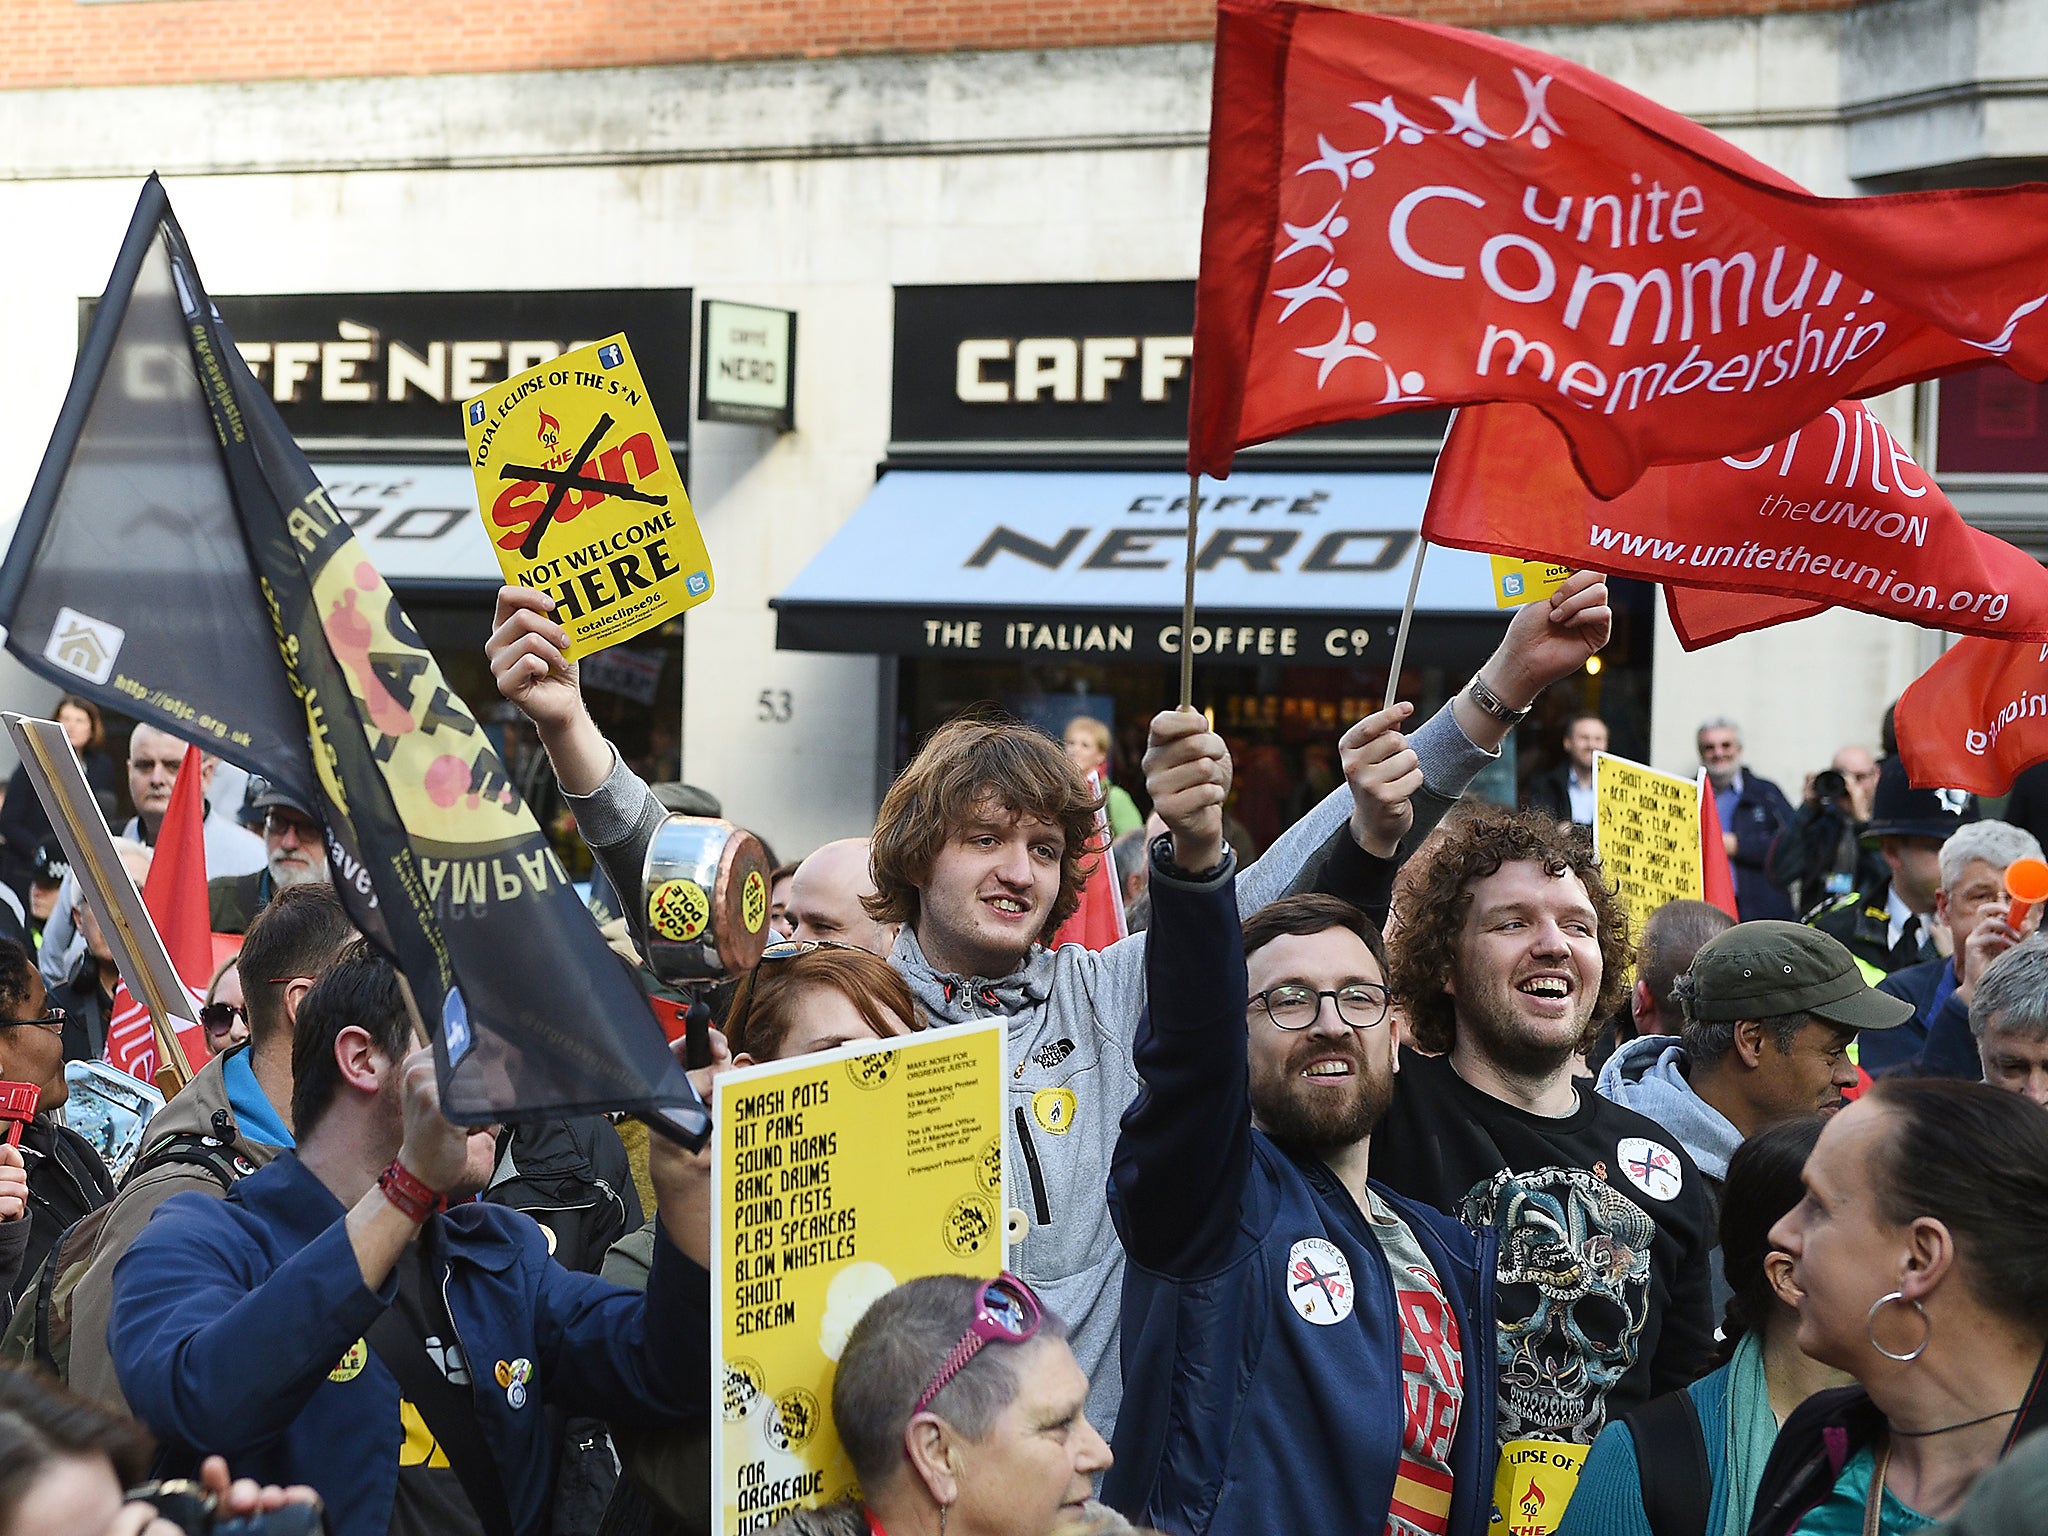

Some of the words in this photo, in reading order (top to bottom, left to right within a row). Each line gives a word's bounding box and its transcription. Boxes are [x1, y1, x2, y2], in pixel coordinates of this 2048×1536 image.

[1522, 172, 1705, 248] unite
[719, 358, 776, 384] NERO
[956, 337, 1193, 401] CAFF
[1476, 312, 1888, 414] membership
[475, 419, 501, 468] TOTAL
[497, 375, 546, 419] ECLIPSE
[549, 371, 570, 387] OF
[574, 371, 604, 391] THE
[542, 430, 558, 446] 96
[540, 448, 574, 471] THE
[1128, 490, 1331, 515] CAFFÈ
[517, 558, 561, 588] NOT
[564, 510, 677, 570] WELCOME
[962, 525, 1419, 573] NERO
[546, 538, 681, 626] HERE
[1590, 524, 2009, 622] www.unitetheunion.org
[576, 591, 662, 636] totaleclipse96
[924, 619, 982, 649] THE
[1004, 622, 1134, 653] ITALIAN
[1158, 625, 1298, 657] COFFEE
[759, 690, 792, 722] 53
[1619, 771, 1642, 789] SHOUT
[666, 901, 690, 926] NOT
[671, 885, 703, 923] DOLE
[655, 906, 684, 937] COAL
[907, 1058, 928, 1070] MAKE
[929, 1054, 952, 1066] NOISE
[953, 1051, 968, 1062] FOR
[1032, 1050, 1063, 1065] NORTH
[1041, 1040, 1059, 1054] THE
[1041, 1056, 1064, 1070] FACE
[906, 1065, 948, 1081] ORGREAVE
[949, 1059, 978, 1073] JUSTICE
[735, 1090, 784, 1122] SMASH
[792, 1080, 829, 1104] POTS
[917, 1095, 938, 1107] March
[735, 1121, 758, 1149] HIT
[766, 1113, 803, 1143] PANS
[735, 1144, 782, 1176] SOUND
[789, 1132, 837, 1159] HORNS
[735, 1174, 773, 1202] BANG
[781, 1161, 830, 1192] DRUMS
[735, 1199, 782, 1230] POUND
[790, 1187, 832, 1215] FISTS
[735, 1226, 773, 1256] PLAY
[781, 1208, 856, 1246] SPEAKERS
[735, 1254, 775, 1283] BLOW
[783, 1235, 855, 1272] WHISTLES
[736, 1278, 783, 1310] SHOUT
[736, 1302, 795, 1337] SCREAM
[738, 1461, 765, 1489] FOR
[1552, 1454, 1575, 1471] OF
[738, 1470, 824, 1513] ORGREAVE
[1523, 1502, 1538, 1515] 96
[736, 1503, 801, 1536] JUSTIC
[1511, 1526, 1547, 1536] THE
